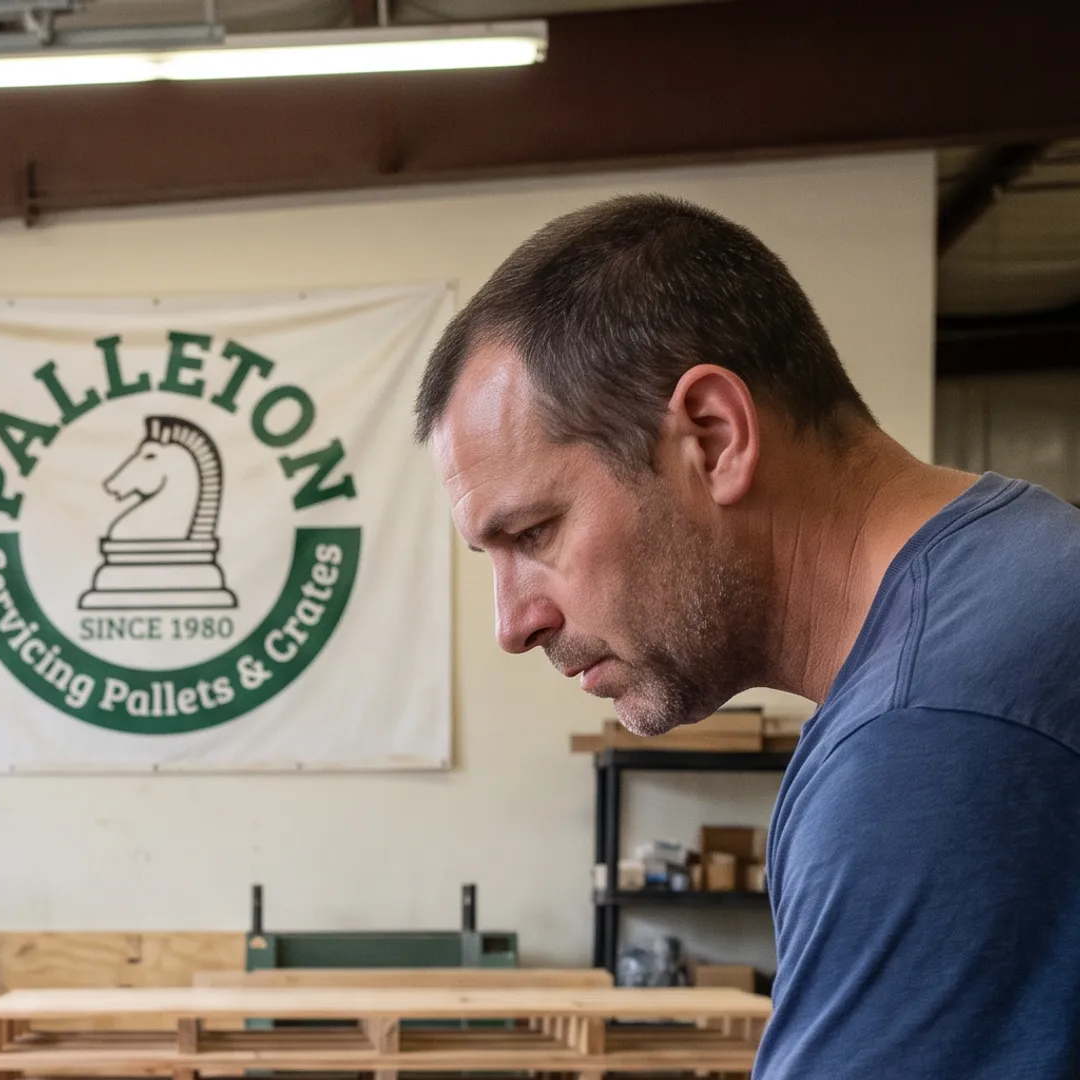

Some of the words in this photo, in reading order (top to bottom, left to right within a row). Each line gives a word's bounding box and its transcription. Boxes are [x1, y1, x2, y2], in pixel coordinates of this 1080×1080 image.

[80, 617, 162, 640] SINCE
[171, 616, 235, 639] 1980
[99, 676, 236, 718] Pallets
[236, 654, 273, 690] &
[264, 543, 343, 663] Crates
